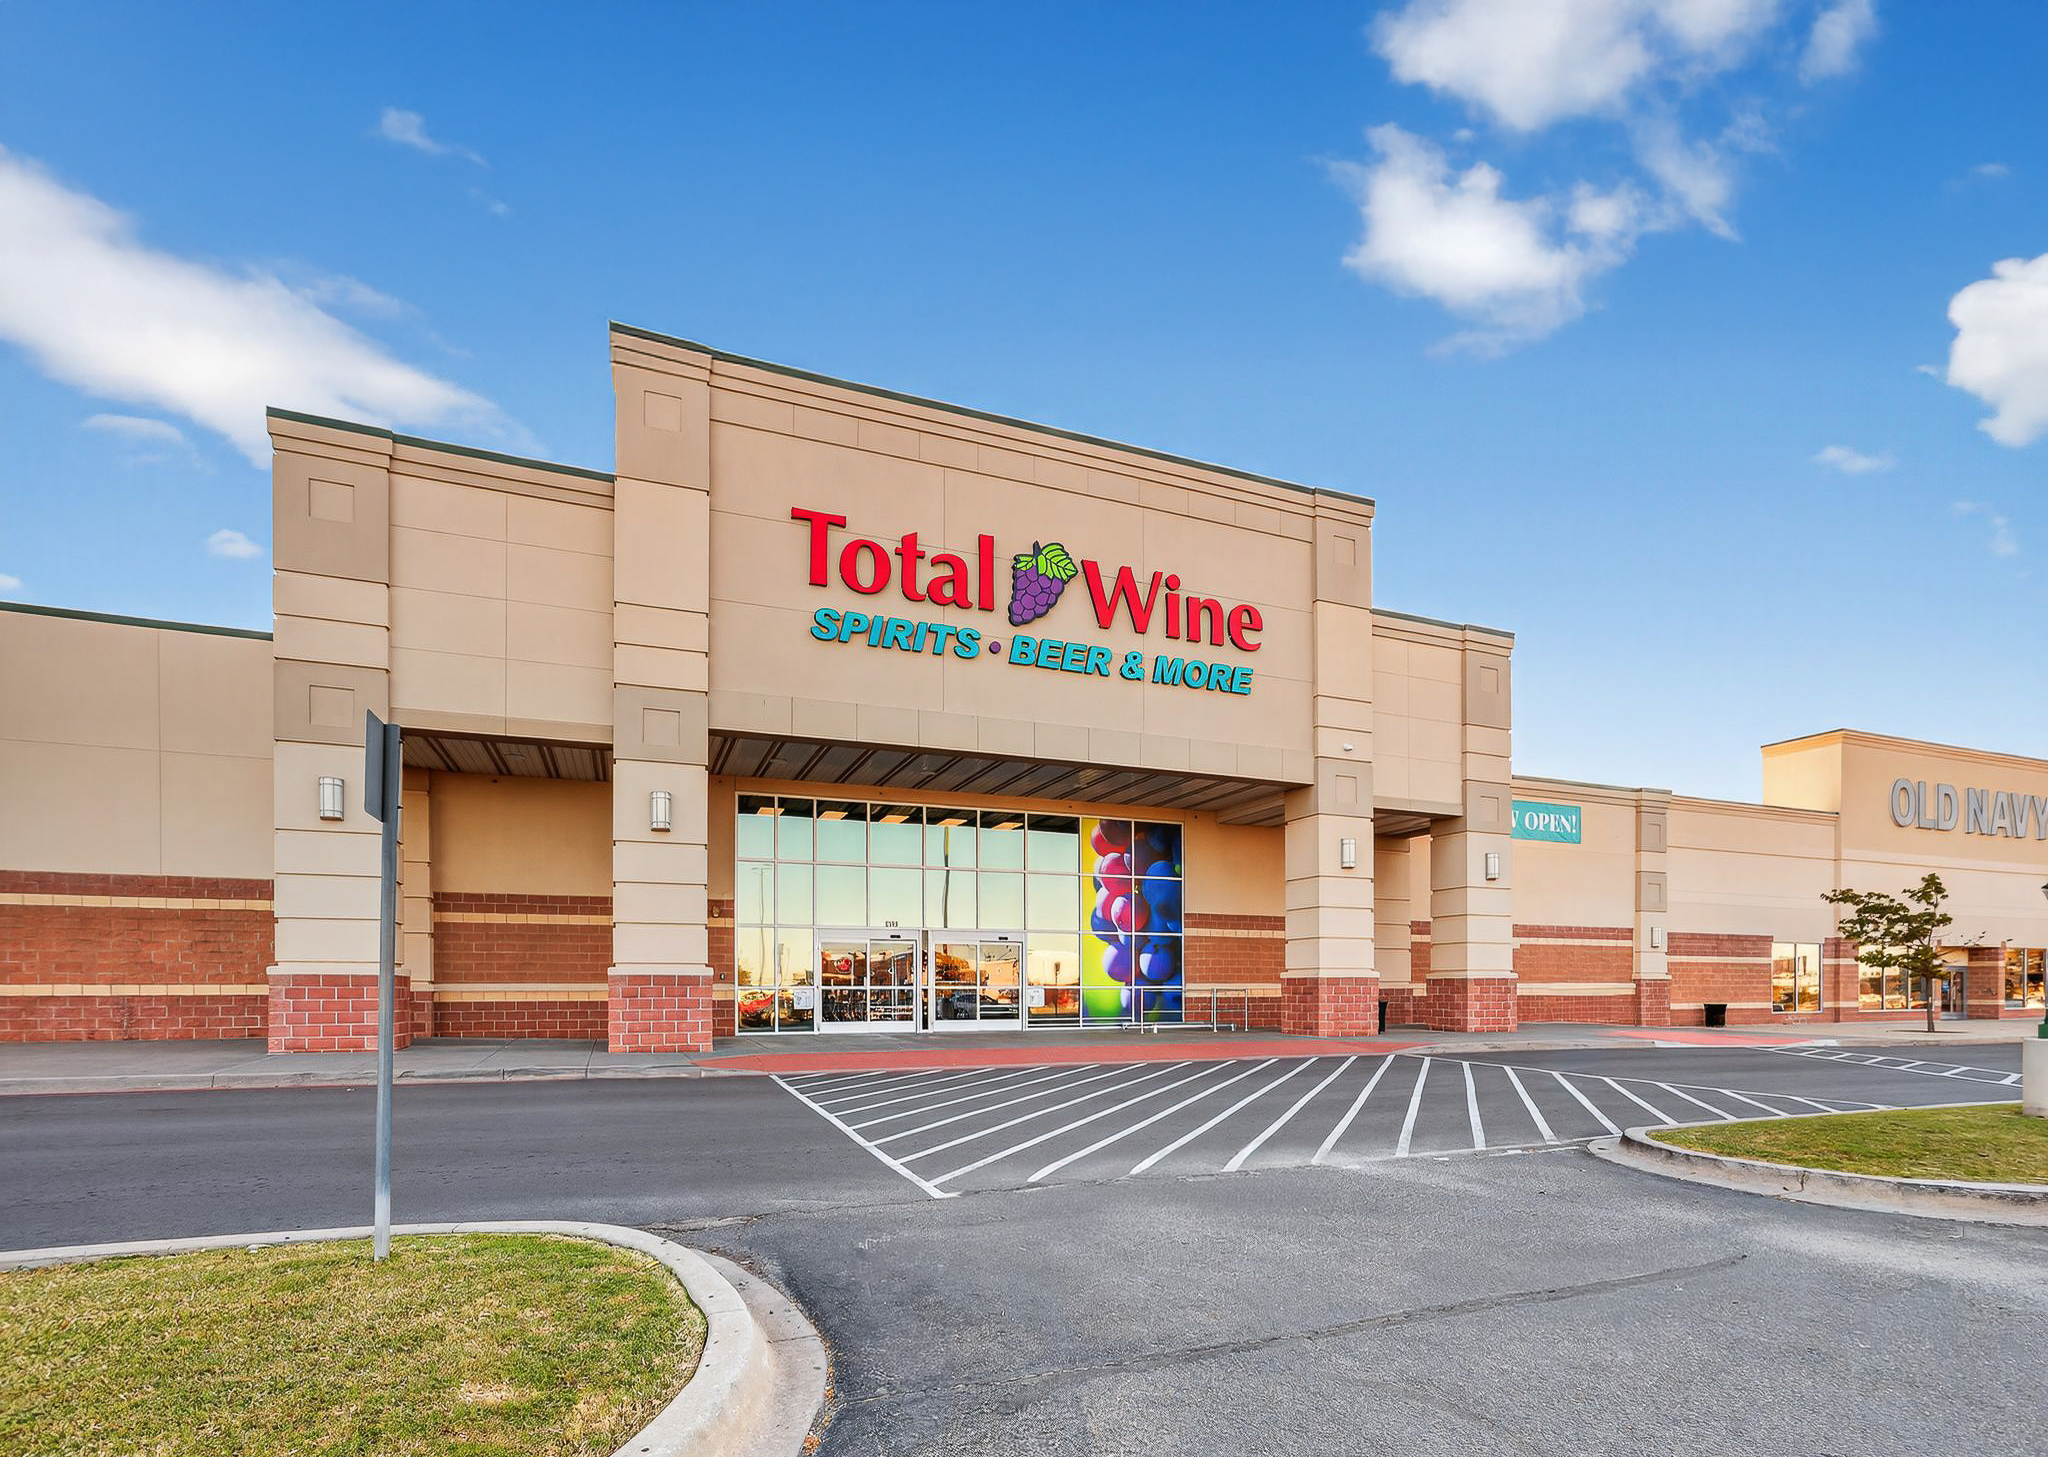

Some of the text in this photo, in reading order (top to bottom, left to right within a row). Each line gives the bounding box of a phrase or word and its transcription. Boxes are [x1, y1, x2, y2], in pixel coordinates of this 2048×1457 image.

[791, 507, 1264, 652] Total Wine
[810, 608, 1254, 695] SPIRITS BEER & MORE
[1526, 811, 1576, 833] OPEN!
[1891, 778, 2048, 840] OLD NAVY
